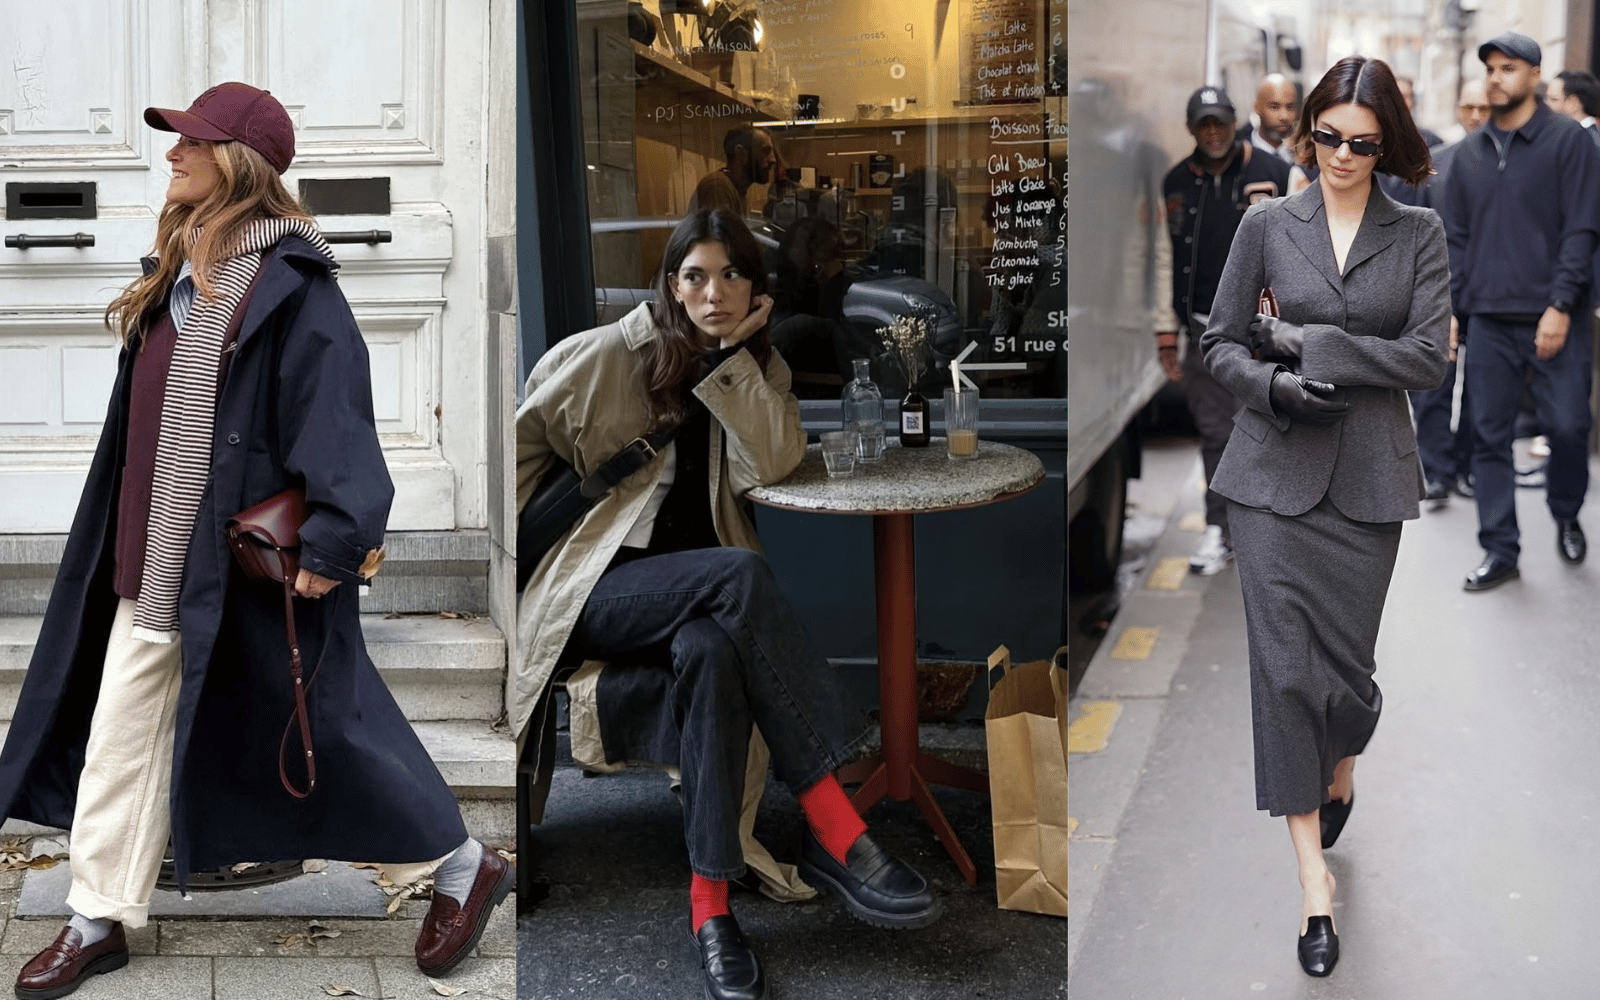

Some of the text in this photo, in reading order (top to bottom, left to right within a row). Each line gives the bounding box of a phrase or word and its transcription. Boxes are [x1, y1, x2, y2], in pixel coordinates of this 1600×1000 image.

[904, 22, 914, 40] 9
[1004, 20, 1028, 36] Latte
[1052, 15, 1061, 26] 5
[707, 40, 753, 54] MAISON
[980, 32, 1063, 59] Matcha Latte 6
[977, 54, 1057, 81] Chocolat chaud 5
[976, 81, 1061, 100] Thé et infusion 4
[655, 104, 681, 123] PJ
[989, 116, 1041, 140] Boissons
[987, 153, 1009, 175] Cold
[992, 200, 1011, 218] Jus
[993, 213, 1066, 234] Jus Mixte 6
[991, 235, 1065, 253] Kombucha 5
[1054, 253, 1063, 267] 5
[985, 271, 1061, 291] Thé glacé 5
[994, 336, 1016, 353] 51
[1024, 339, 1056, 353] rue
